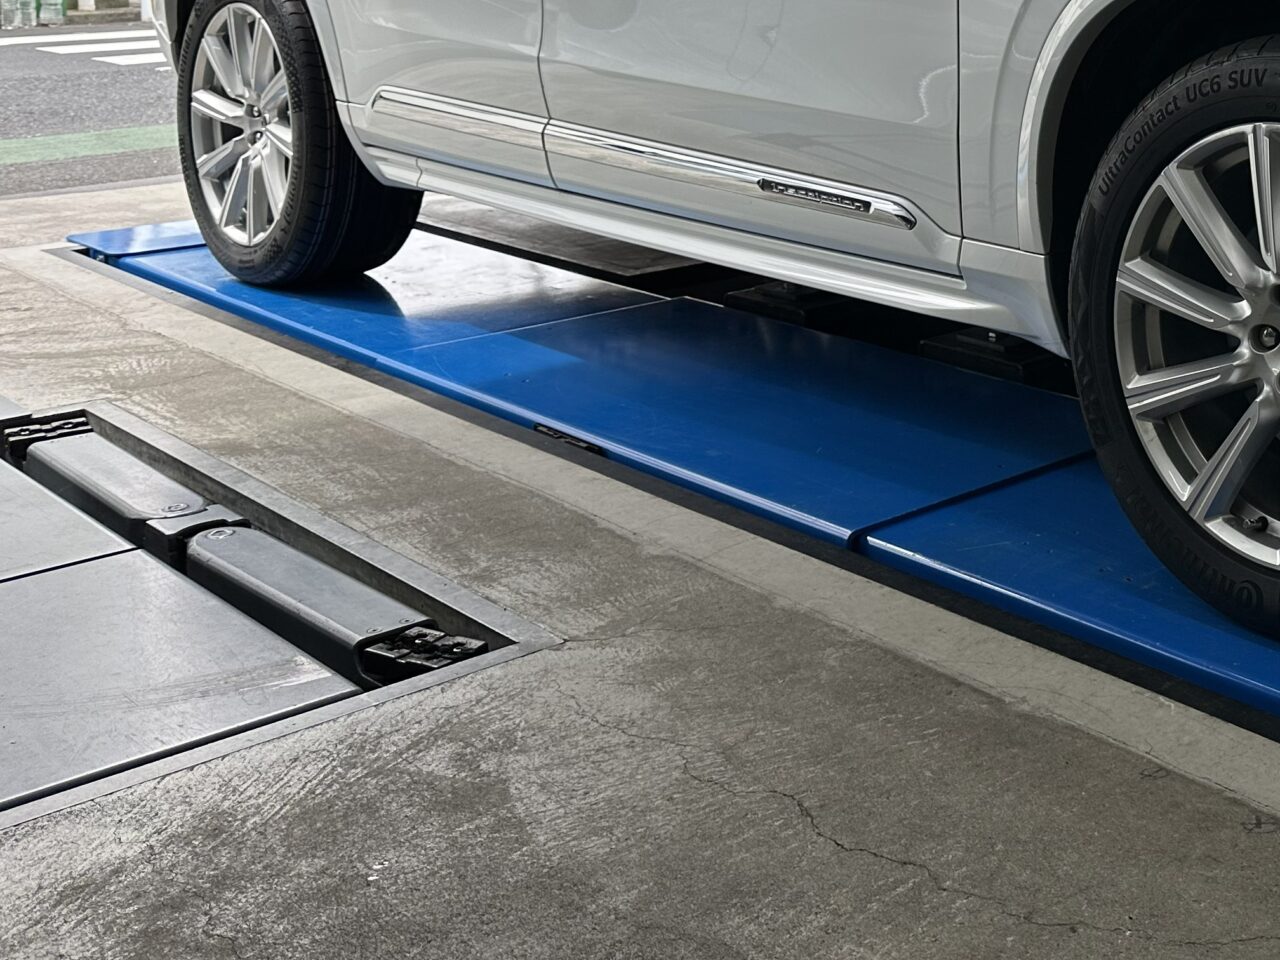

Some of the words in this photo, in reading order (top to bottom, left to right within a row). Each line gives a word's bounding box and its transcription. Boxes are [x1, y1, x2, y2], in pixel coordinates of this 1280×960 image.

[1099, 95, 1181, 196] UltraContact
[1185, 75, 1221, 103] UC6
[1228, 68, 1268, 90] SUV
